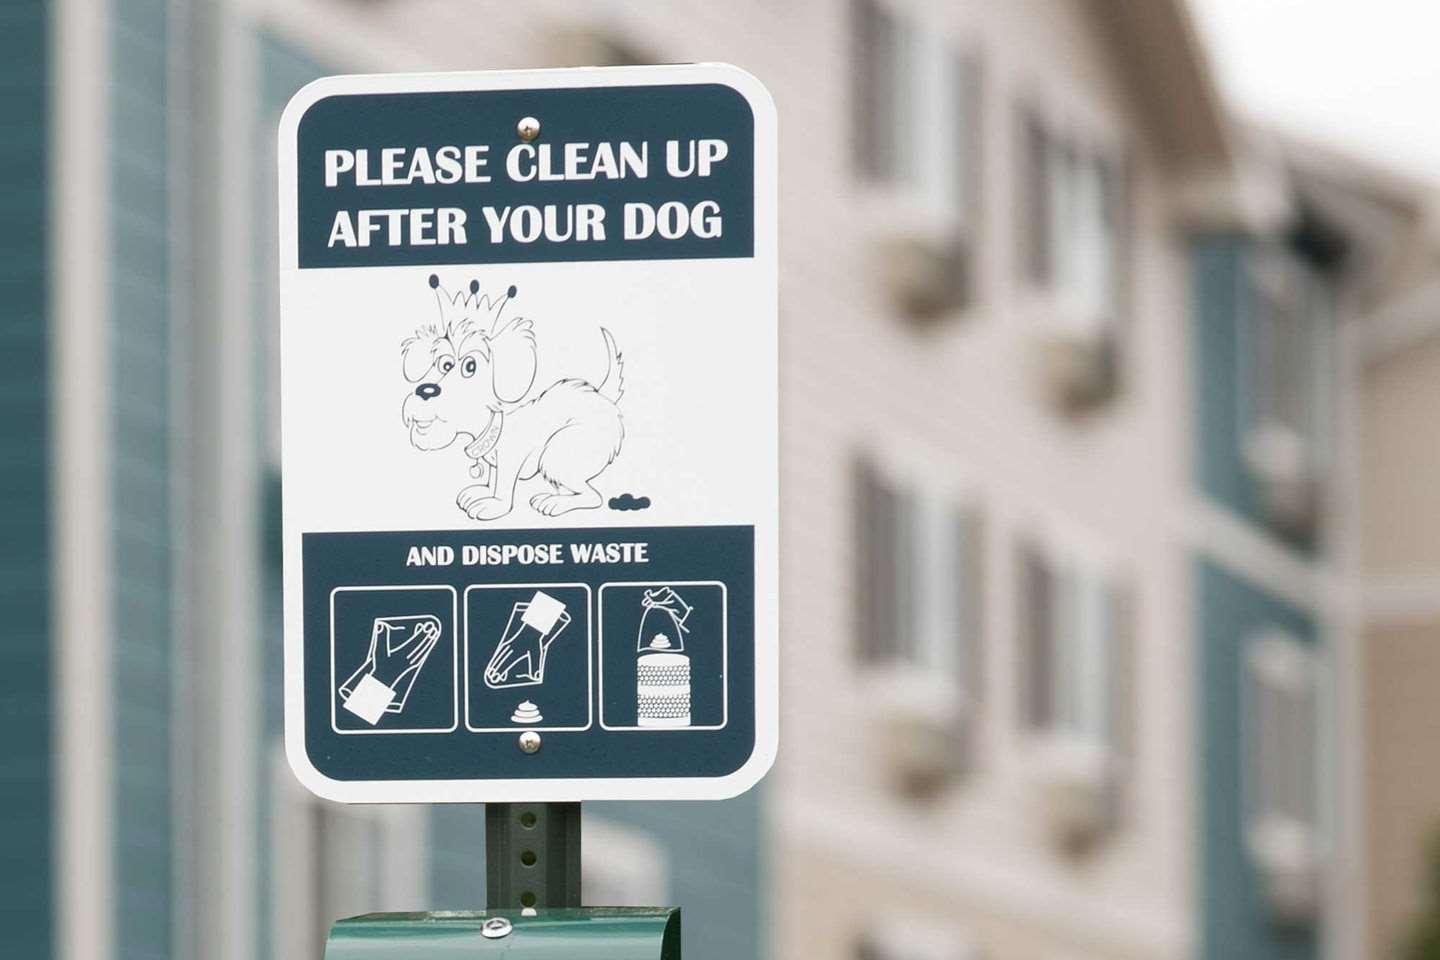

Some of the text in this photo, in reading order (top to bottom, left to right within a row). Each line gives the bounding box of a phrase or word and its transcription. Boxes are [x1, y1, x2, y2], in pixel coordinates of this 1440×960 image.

[324, 138, 729, 188] PLEASE CLEAN UP
[327, 200, 723, 248] AFTER YOUR DOG
[406, 542, 650, 567] AND DISPOSE WASTE
